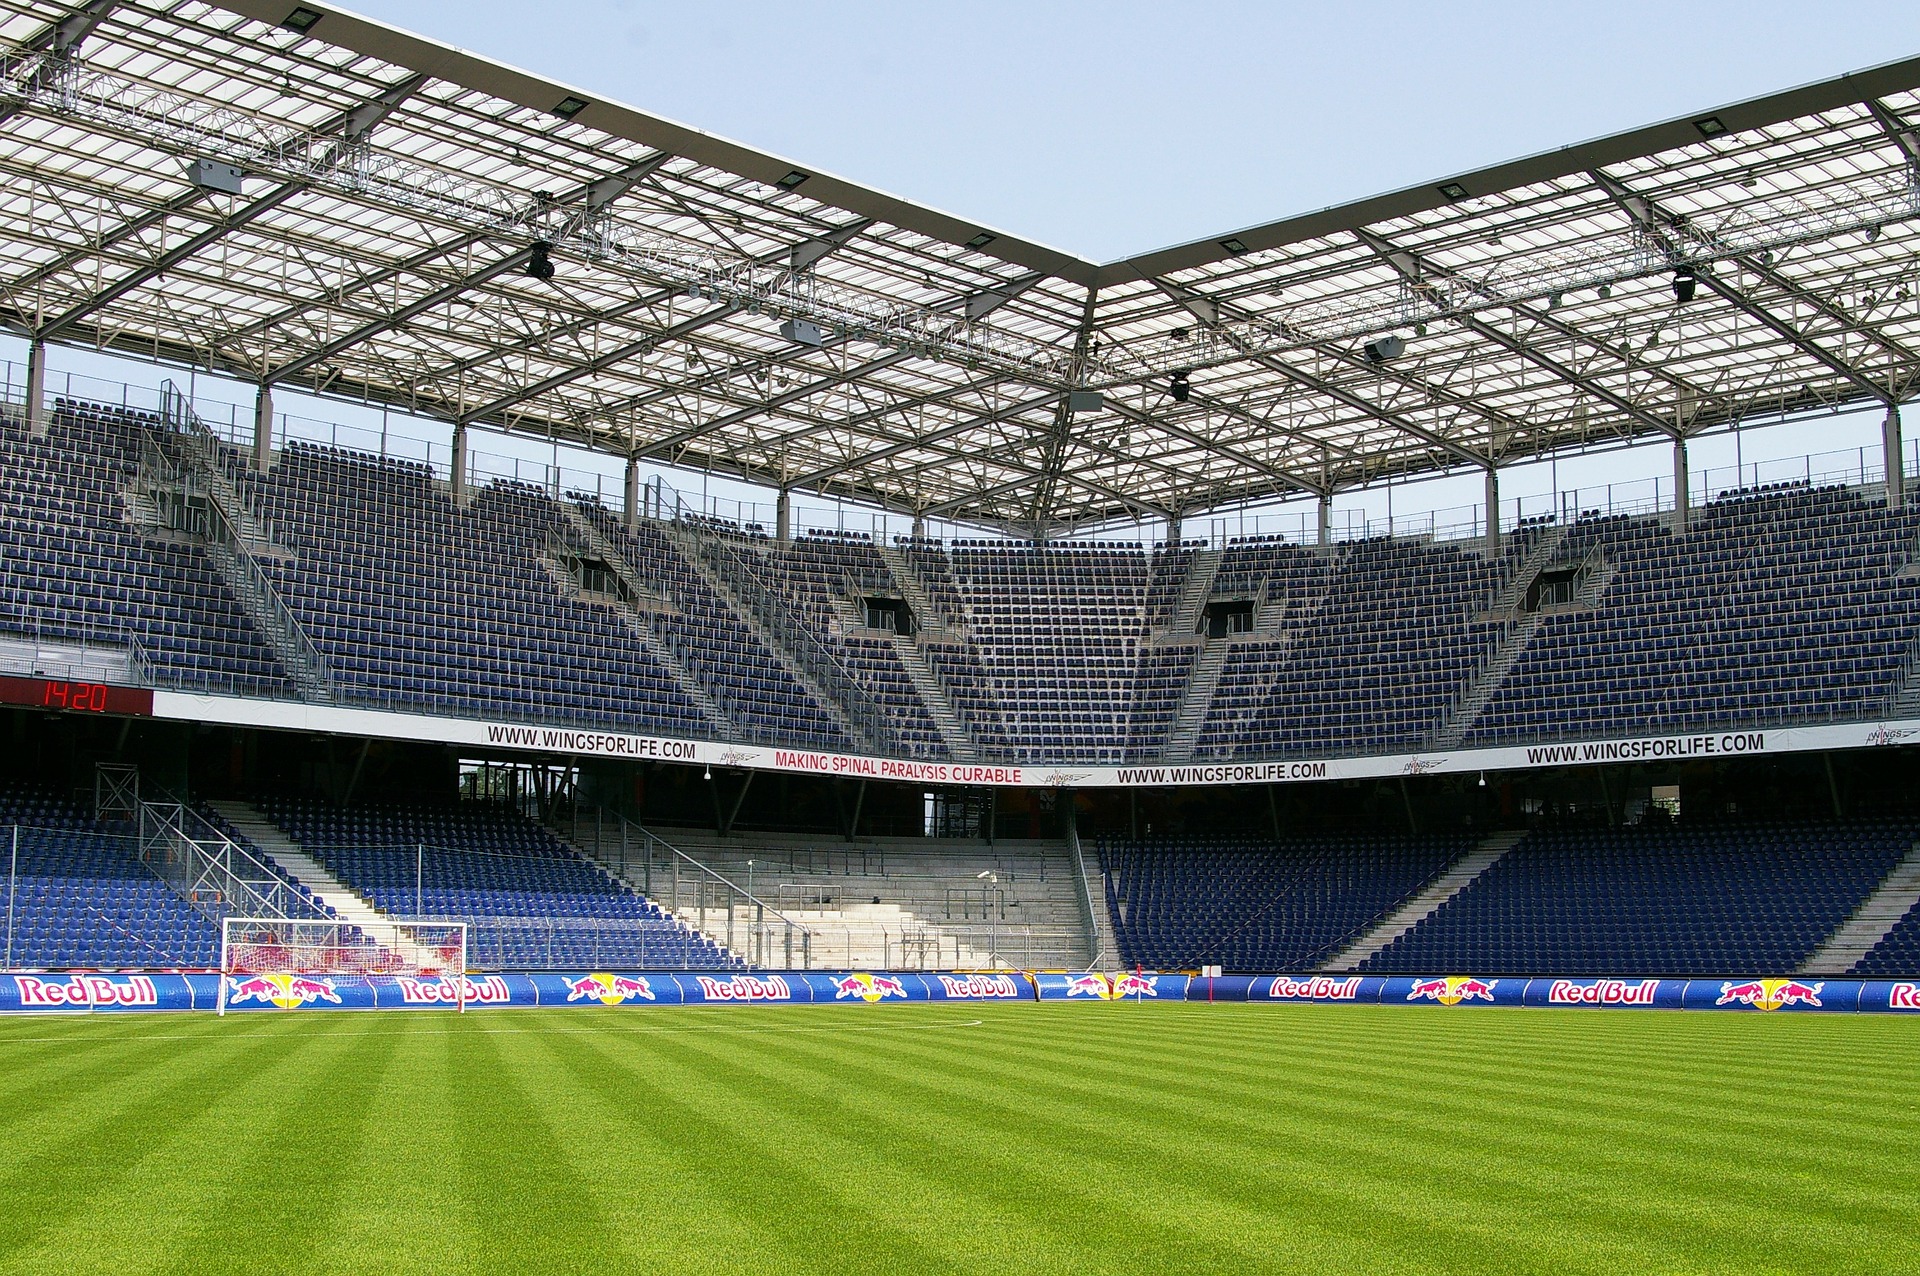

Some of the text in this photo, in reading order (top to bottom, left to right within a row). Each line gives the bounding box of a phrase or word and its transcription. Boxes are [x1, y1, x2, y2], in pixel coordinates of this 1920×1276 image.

[487, 725, 697, 760] WWW.WINGSFORLIFE.COM
[1527, 733, 1765, 764] WWW.WINGSFORLIFE.COM
[775, 751, 1022, 783] MAKING SPINAL PARALYSIS CURABLE
[1117, 762, 1327, 784] WWW.WINGSFORLIFE.COM
[19, 977, 156, 1003] Red Bull
[399, 978, 457, 1002] Red
[699, 977, 789, 999] Red Bull
[941, 976, 1016, 996] Red Bull
[1270, 978, 1360, 998] Red Bull
[1550, 981, 1657, 1003] Red Bull
